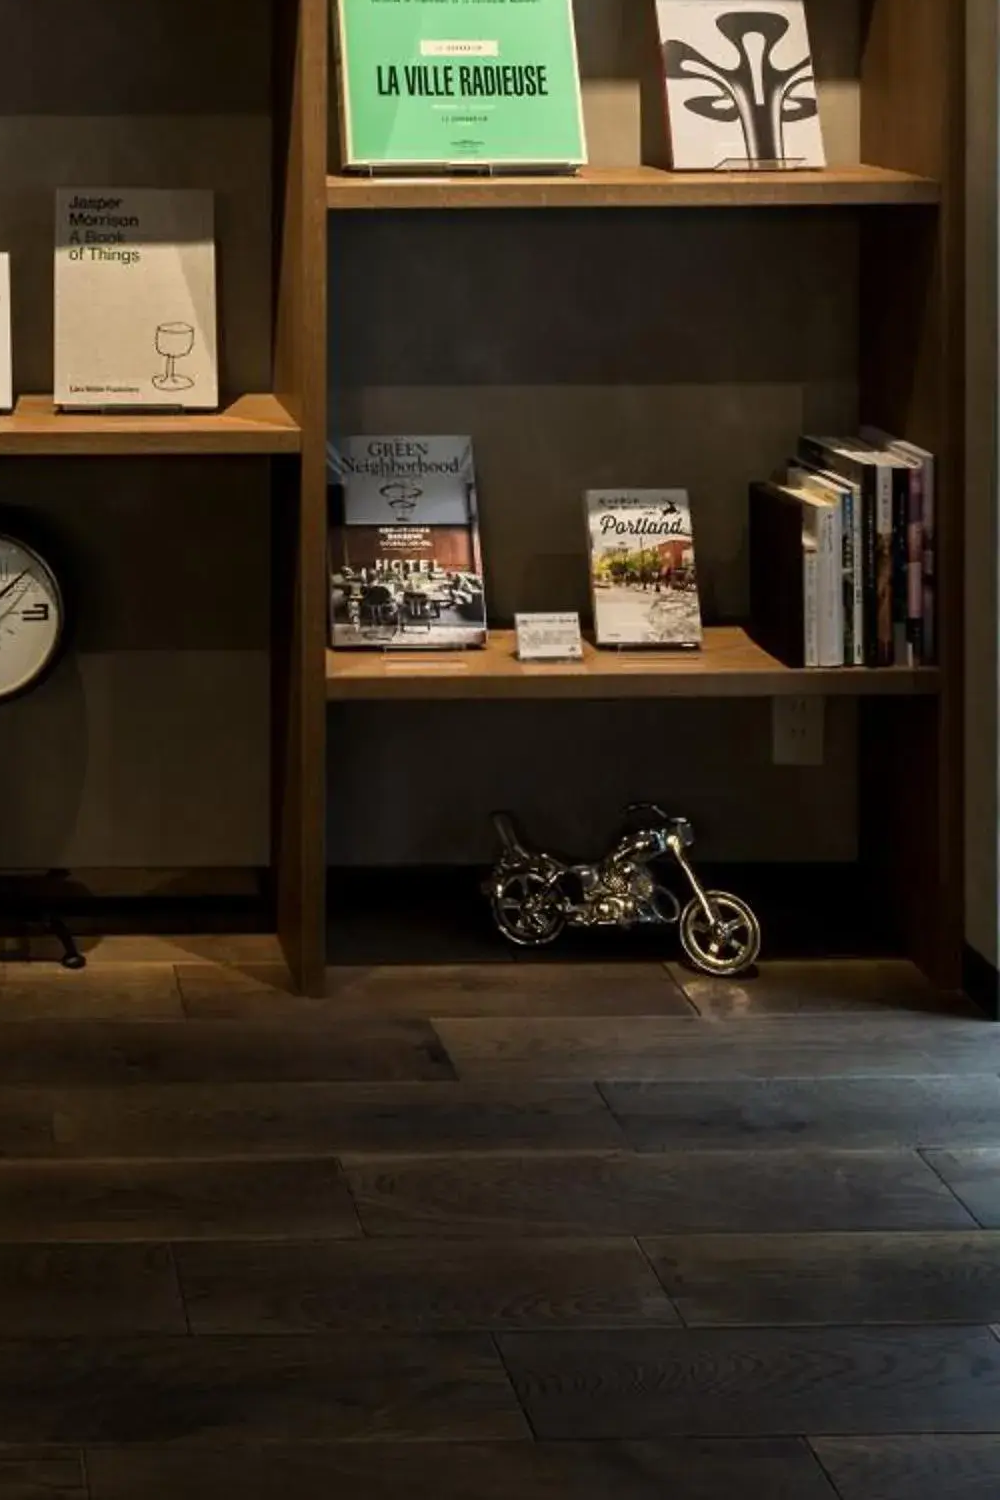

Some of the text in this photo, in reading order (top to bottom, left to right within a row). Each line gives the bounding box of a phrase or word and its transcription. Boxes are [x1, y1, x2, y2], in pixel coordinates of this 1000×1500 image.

[376, 65, 548, 97] LA VILLE RADIEUSE
[68, 195, 124, 211] Jasper
[68, 213, 140, 228] Morrison
[69, 230, 125, 244] A Book
[69, 247, 141, 265] of Things
[367, 441, 429, 457] GREEN
[341, 455, 460, 476] Neighborhood
[600, 514, 690, 536] Portland
[375, 558, 443, 573] HOTEL
[22, 603, 49, 621] 3
